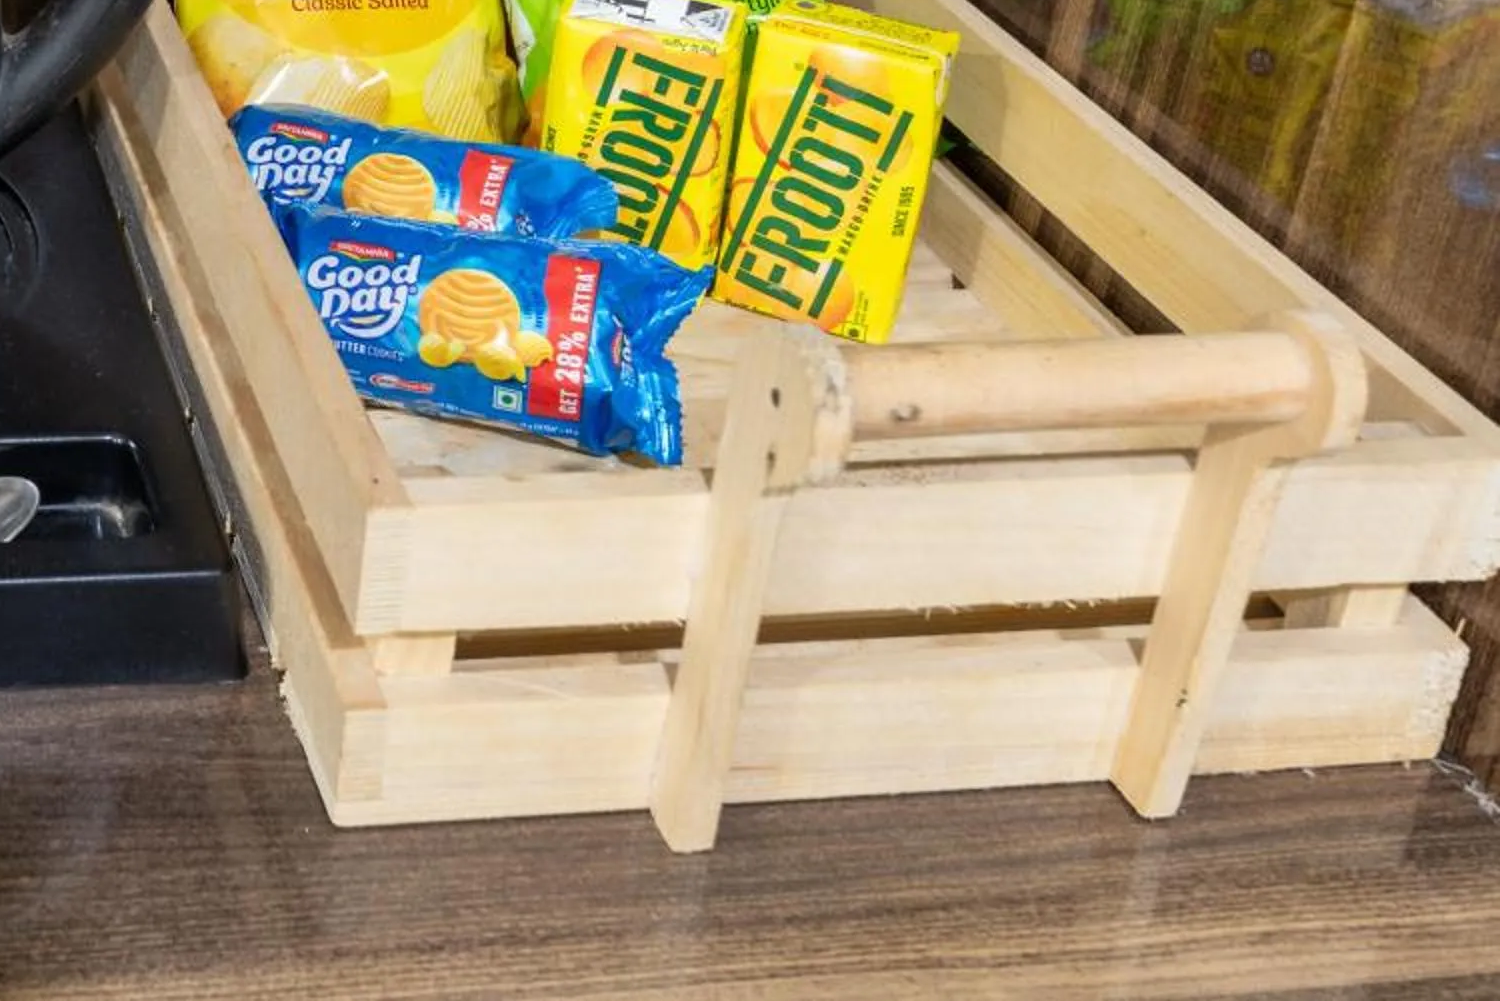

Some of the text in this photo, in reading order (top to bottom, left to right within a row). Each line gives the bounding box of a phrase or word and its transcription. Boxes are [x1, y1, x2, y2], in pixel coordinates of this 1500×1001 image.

[247, 136, 353, 165] Good
[257, 162, 337, 205] Day
[734, 75, 895, 311] FROOTI
[307, 254, 422, 289] Good
[321, 285, 408, 338] Day
[553, 273, 596, 414] GET 28% EXTRA
